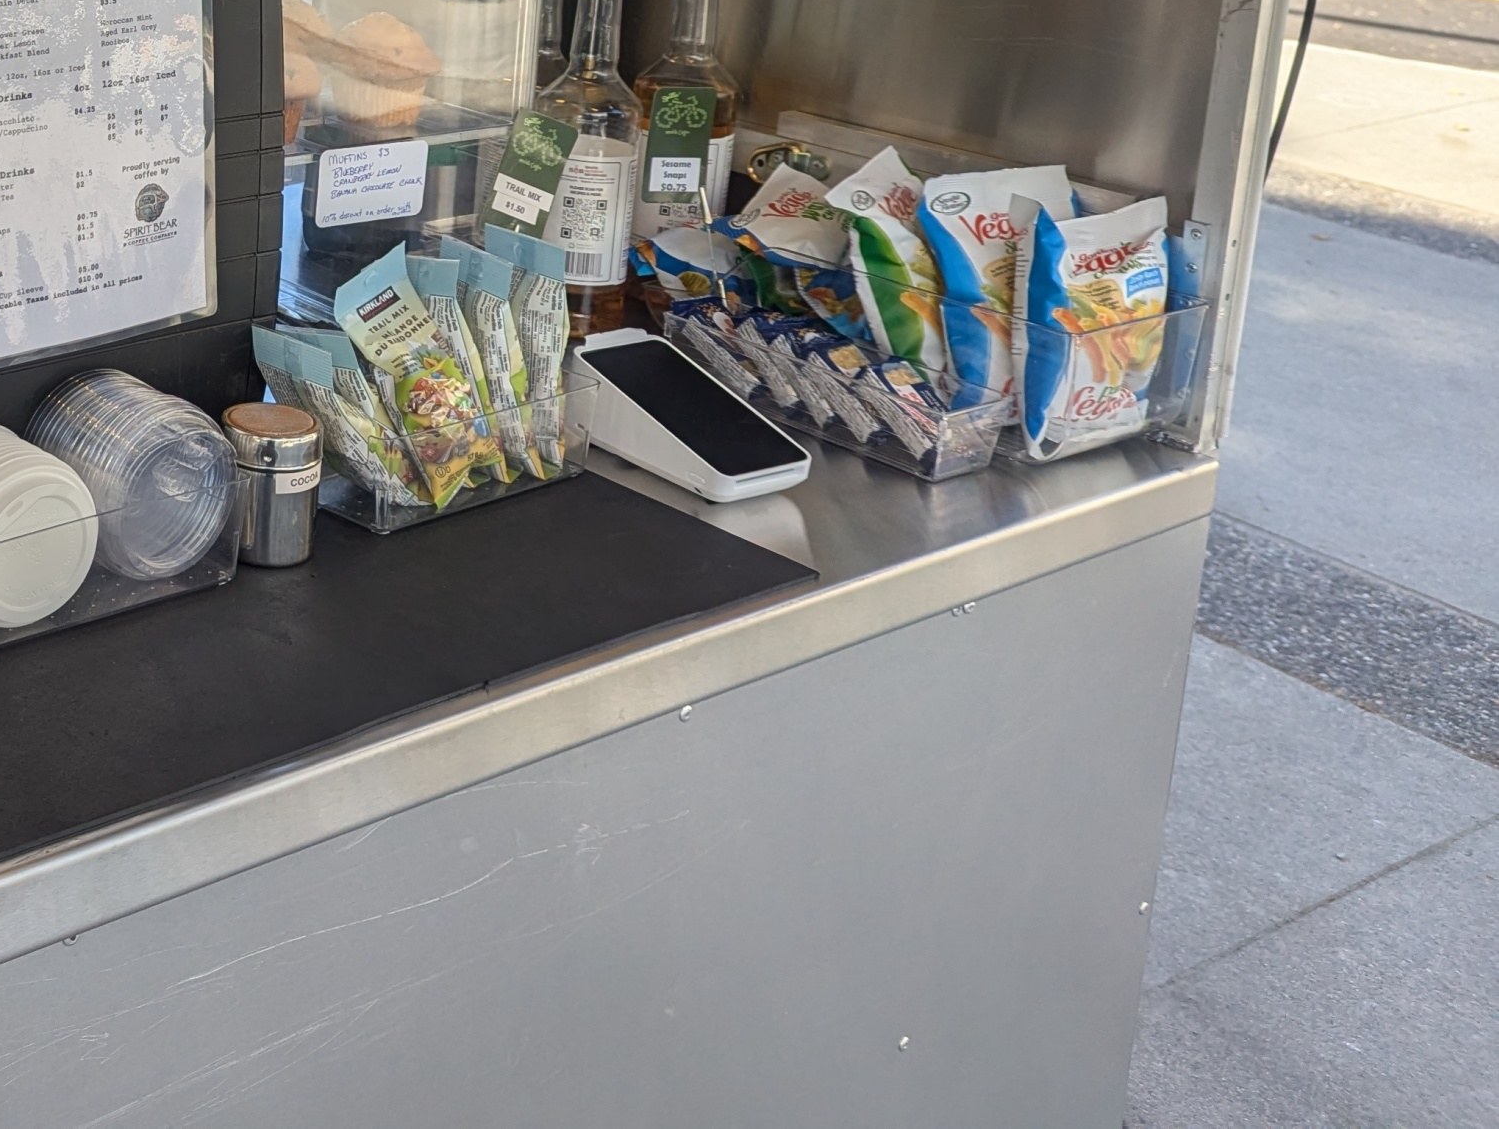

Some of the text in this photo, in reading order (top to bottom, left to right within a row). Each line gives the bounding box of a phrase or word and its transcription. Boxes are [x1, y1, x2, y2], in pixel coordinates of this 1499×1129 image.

[100, 23, 157, 37] Aged Earl Grey
[13, 40, 36, 48] Lemon
[101, 38, 130, 47] Rooibos
[27, 48, 50, 56] Blend
[101, 60, 110, 68] $4
[6, 72, 29, 82] 12oz,
[33, 69, 51, 77] 16oz
[68, 64, 86, 73] Iced
[74, 70, 176, 92] 4oz 12oz 16oz Iced
[74, 106, 95, 115] $4.25
[107, 113, 115, 121] $5
[108, 133, 116, 141] $5
[122, 156, 180, 173] Proudly serving
[661, 160, 692, 168] Sesame
[0, 167, 35, 179] Drinks
[76, 169, 93, 179] $1.5
[134, 170, 157, 180] coffee
[663, 171, 687, 179] Snaps
[506, 182, 542, 202] TRAIL MIX
[661, 183, 687, 192] $0.75
[505, 201, 526, 214] $1.50
[77, 211, 98, 221] $0.75
[77, 223, 94, 232] $1.5
[123, 219, 178, 239] SPIRIT BEAR
[958, 213, 1015, 246] Veg
[78, 233, 94, 242] $1.5
[128, 237, 148, 246] COFFEE
[78, 263, 99, 273] $5.00
[78, 273, 103, 284] $10.00
[0, 292, 13, 300] Cup
[17, 286, 44, 295] Sleeve
[26, 295, 49, 304] Taxes
[53, 287, 88, 299] included
[103, 280, 115, 288] all
[119, 275, 143, 286] prices
[359, 289, 395, 316] KIRKLAND
[368, 318, 392, 333] TRAIL
[392, 304, 410, 319] MIX
[375, 343, 388, 356] DU
[290, 471, 318, 487] COCOA
